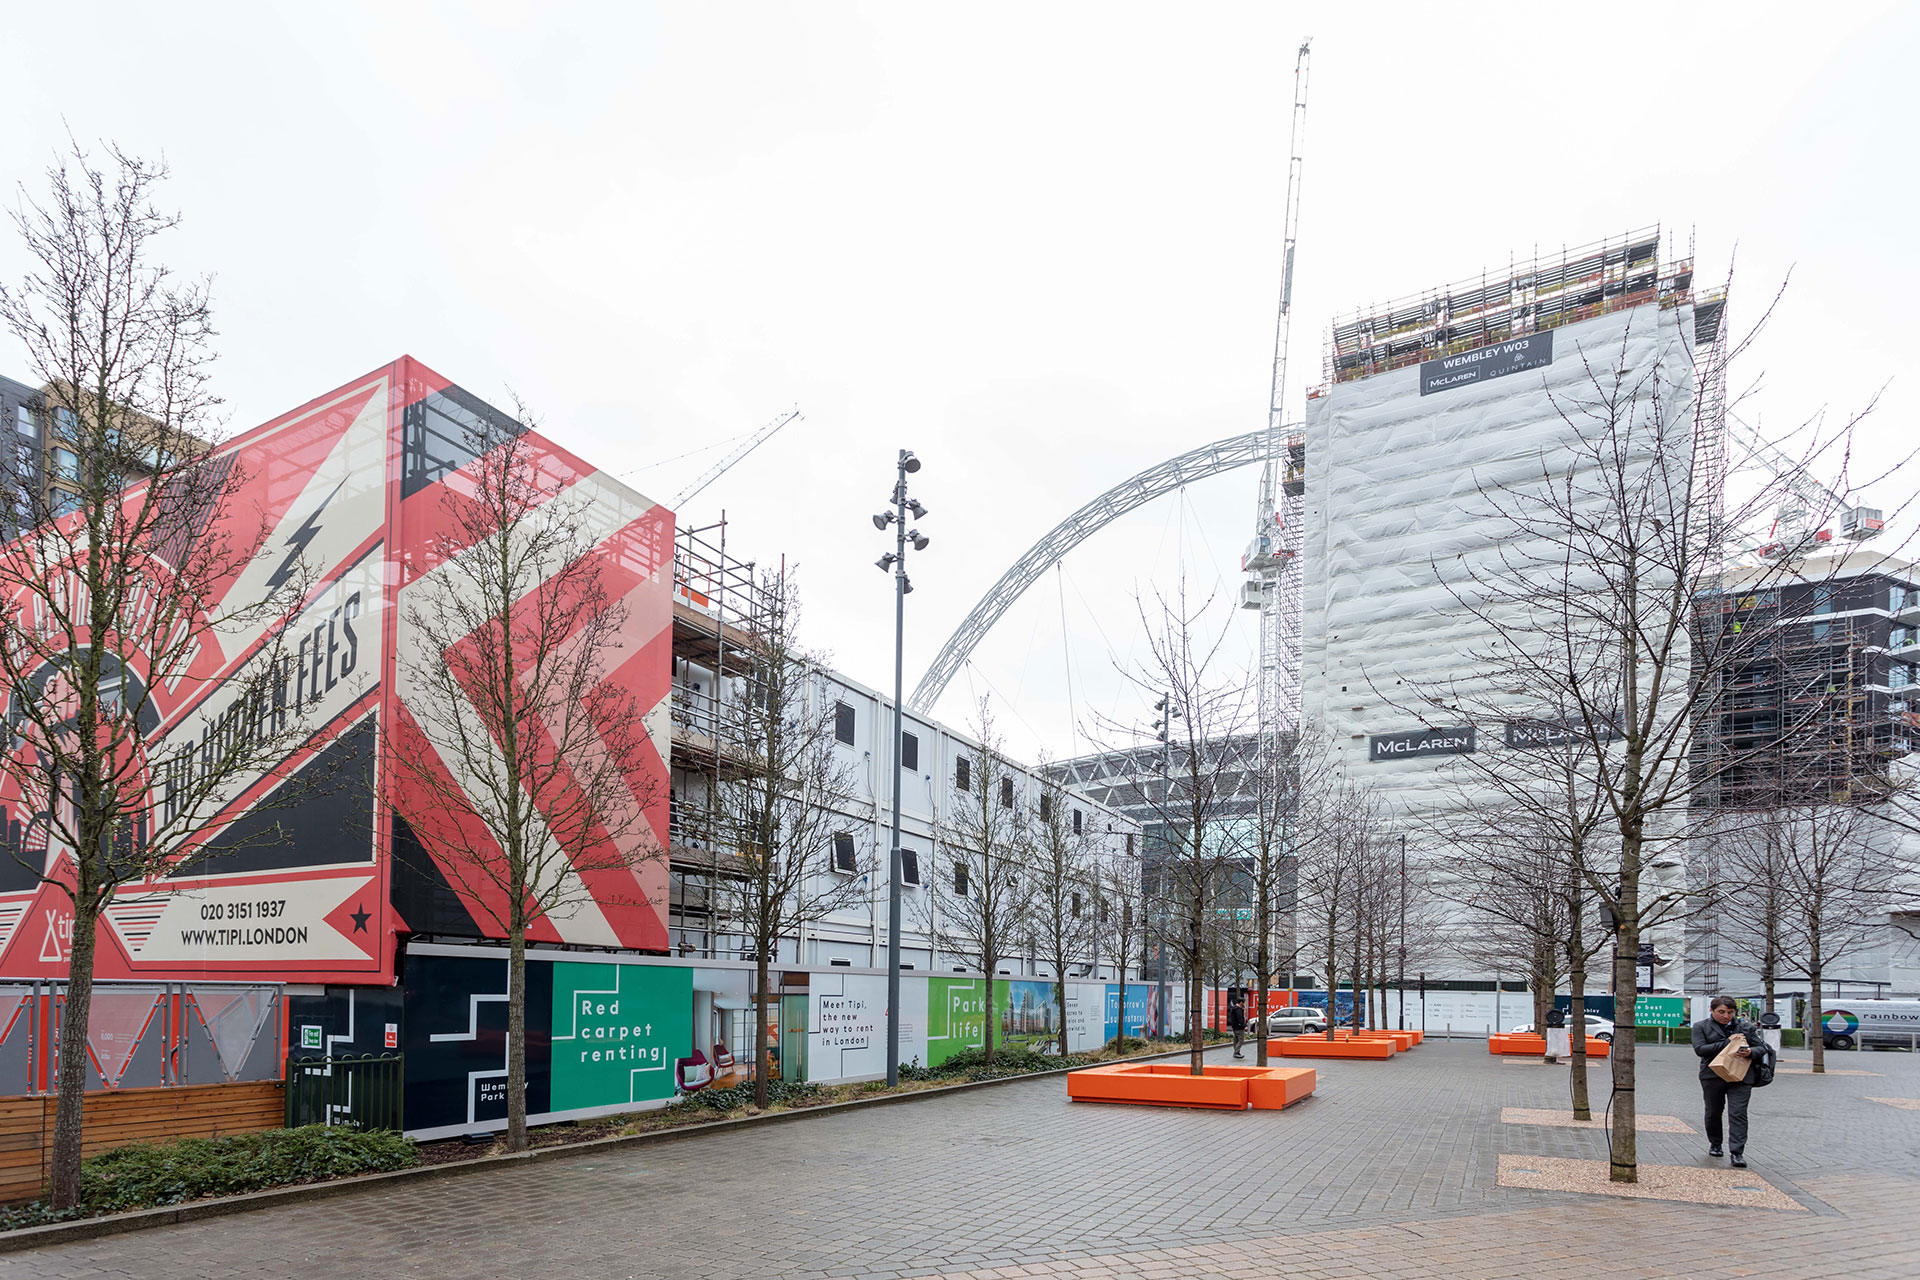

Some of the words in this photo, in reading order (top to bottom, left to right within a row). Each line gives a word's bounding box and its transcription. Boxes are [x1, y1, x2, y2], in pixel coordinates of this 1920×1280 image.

[1443, 347, 1501, 369] WEMBLEY
[1504, 340, 1529, 354] W03
[1430, 371, 1476, 388] McLAREN
[1489, 357, 1546, 377] QUINTAIN
[105, 567, 202, 697] BELLION
[164, 739, 194, 827] NO
[199, 650, 289, 786] HIDDEN
[295, 590, 361, 719] FEES
[1376, 736, 1468, 755] McLAREN
[200, 904, 224, 921] 020
[227, 902, 252, 919] 3151
[255, 900, 287, 918] 1937
[58, 912, 76, 946] tip
[181, 926, 308, 946] WWW.TIPI.LONDON
[581, 1000, 619, 1015] Red
[822, 1000, 845, 1009] Meet
[848, 1000, 867, 1010] Tipi,
[953, 995, 985, 1013] Park
[1110, 999, 1145, 1009] Toorrow's
[822, 1012, 838, 1021] the
[841, 1013, 858, 1021] new
[1110, 1014, 1143, 1024] surstars
[1863, 1013, 1919, 1021] rainbow
[581, 1023, 652, 1040] carpet
[822, 1026, 840, 1034] way
[843, 1024, 853, 1032] to
[856, 1024, 873, 1032] rent
[952, 1020, 979, 1039] life
[822, 1037, 831, 1046] in
[834, 1036, 865, 1046] London
[581, 1045, 659, 1062] renting
[481, 1082, 529, 1092] Wemy
[481, 1092, 505, 1101] Park
